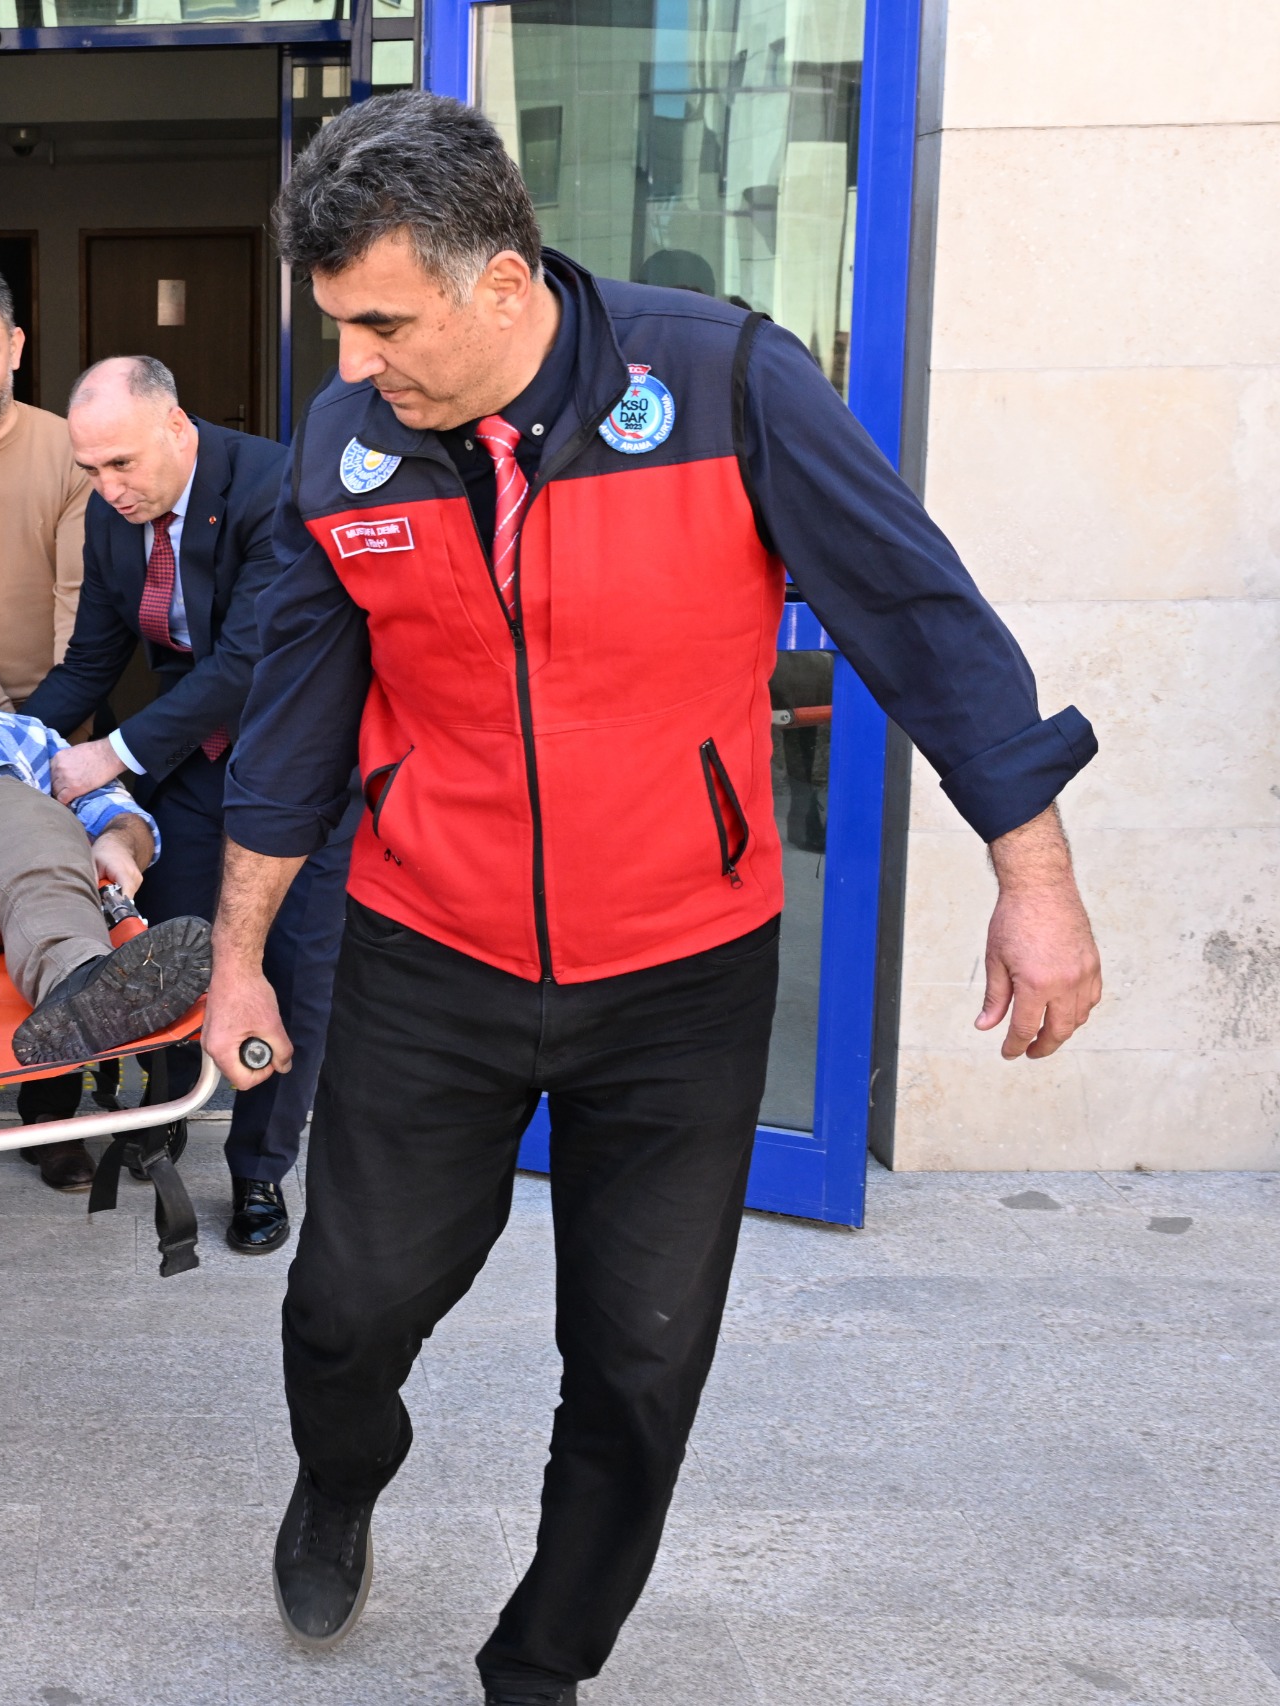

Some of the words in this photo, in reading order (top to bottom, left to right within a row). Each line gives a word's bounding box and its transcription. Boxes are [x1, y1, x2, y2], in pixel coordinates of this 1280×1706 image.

[621, 398, 648, 411] KSÜ
[620, 412, 647, 423] DAK
[620, 441, 653, 450] ARAMA
[654, 394, 672, 440] KURTARMA
